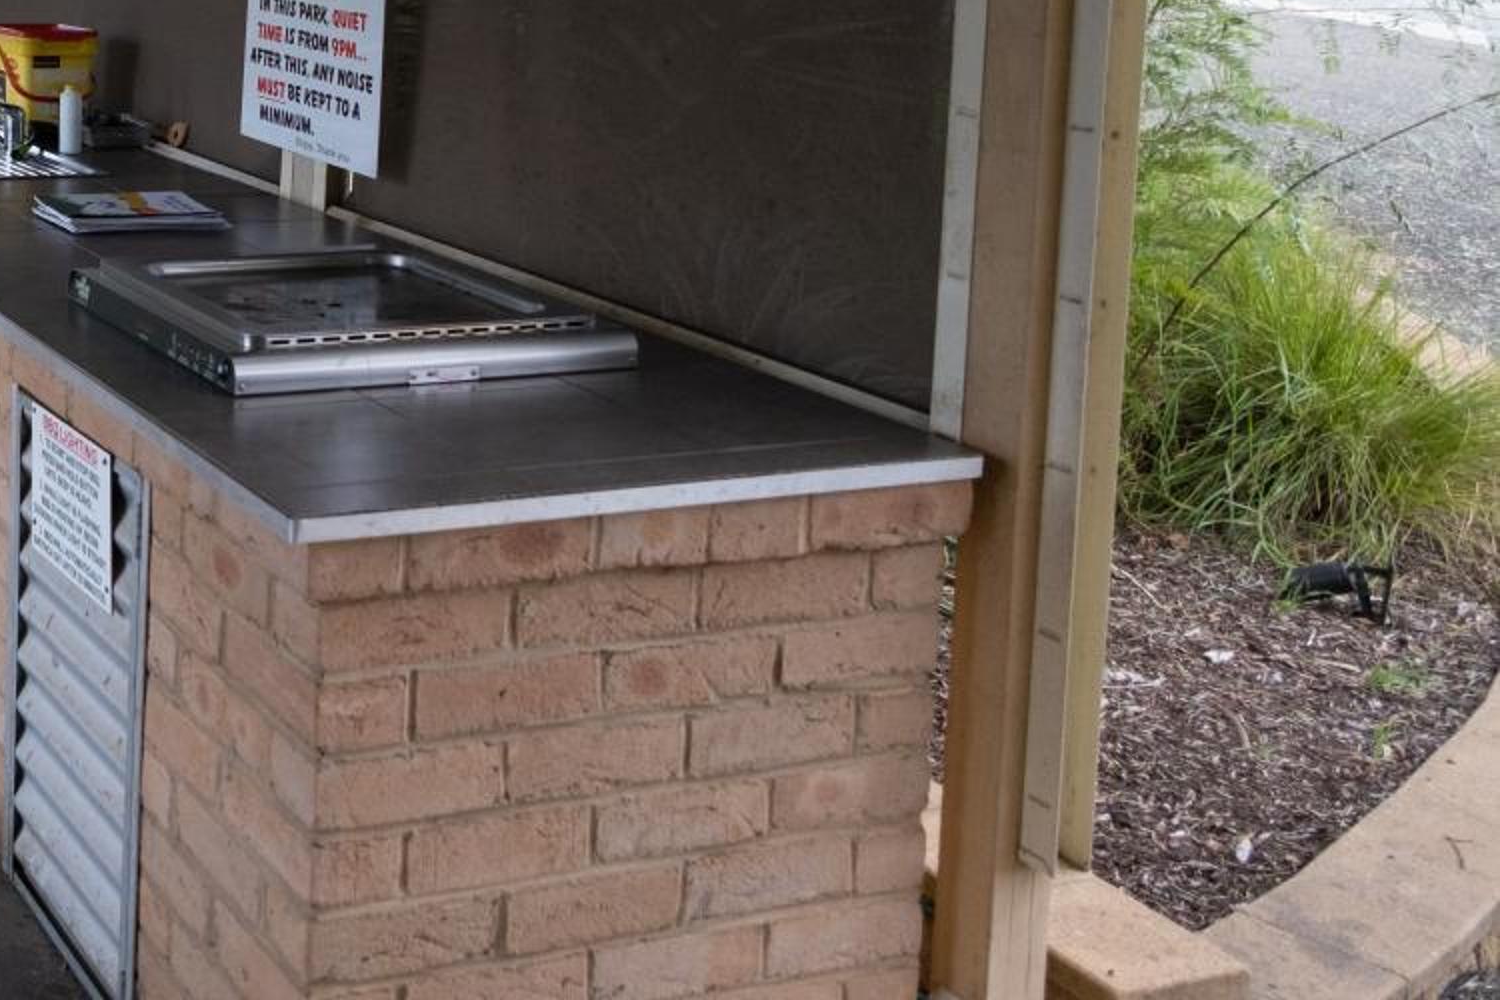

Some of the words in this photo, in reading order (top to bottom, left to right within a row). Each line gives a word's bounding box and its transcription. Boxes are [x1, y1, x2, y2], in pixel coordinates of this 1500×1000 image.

[258, 22, 283, 43] TIME
[285, 26, 295, 45] IS
[299, 30, 328, 52] FROM
[333, 9, 367, 32] QUIET
[251, 48, 280, 70] AFTER
[313, 62, 334, 84] ANY
[337, 69, 372, 94] NOISE
[258, 76, 284, 98] MUST
[288, 83, 300, 103] BE
[304, 88, 331, 112] KEPT
[335, 96, 348, 117] TO
[352, 101, 360, 120] A
